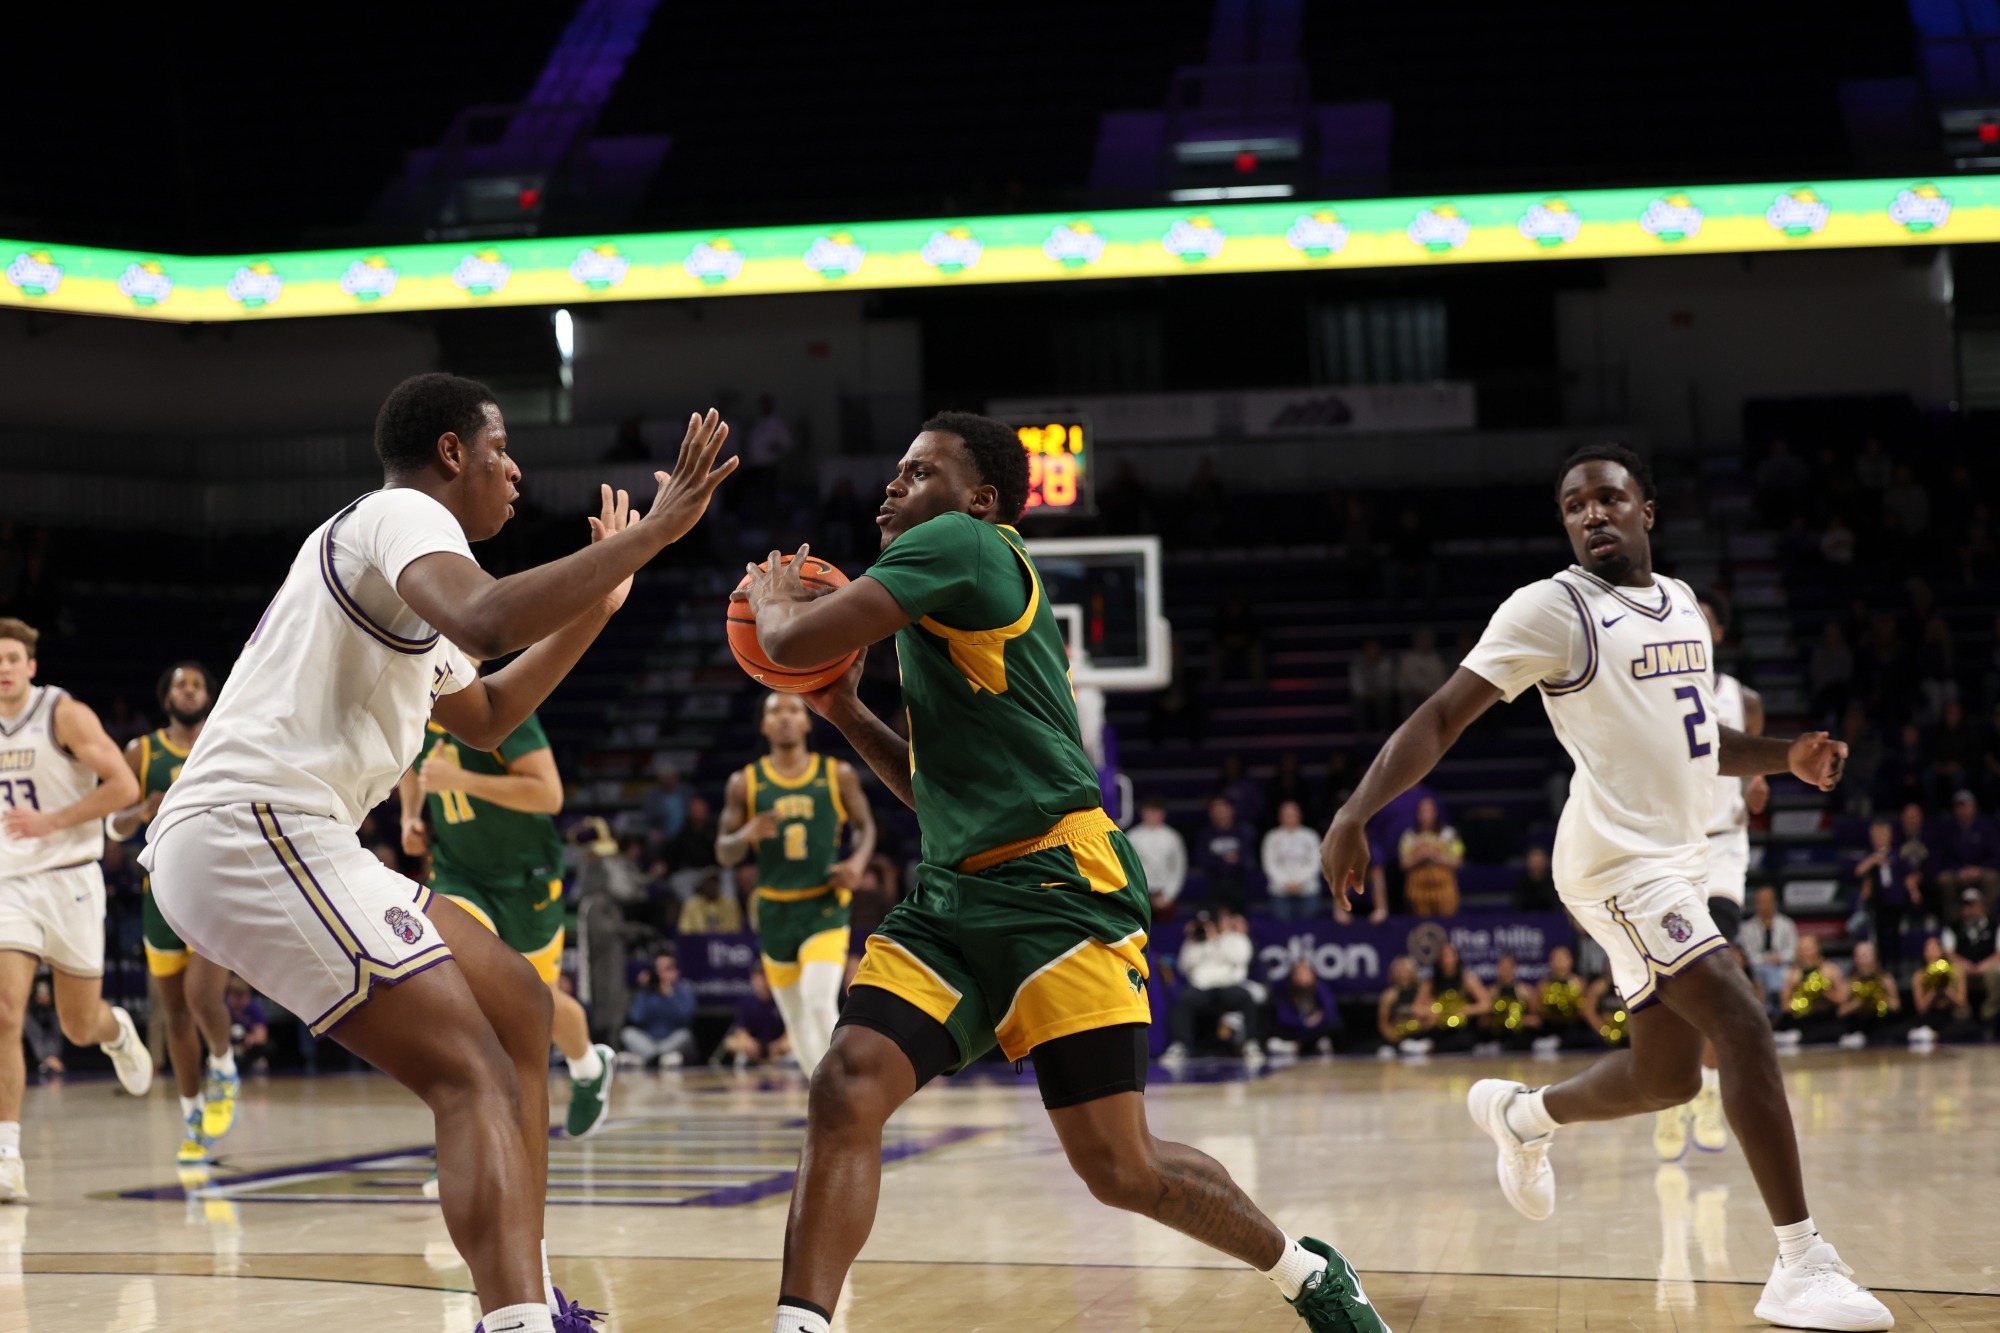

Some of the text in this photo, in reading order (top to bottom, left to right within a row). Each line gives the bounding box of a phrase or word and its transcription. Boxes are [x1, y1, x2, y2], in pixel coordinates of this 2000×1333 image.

[1632, 640, 1707, 680] JMU
[1673, 685, 1711, 758] 2
[0, 748, 35, 771] MU
[784, 824, 808, 859] 2
